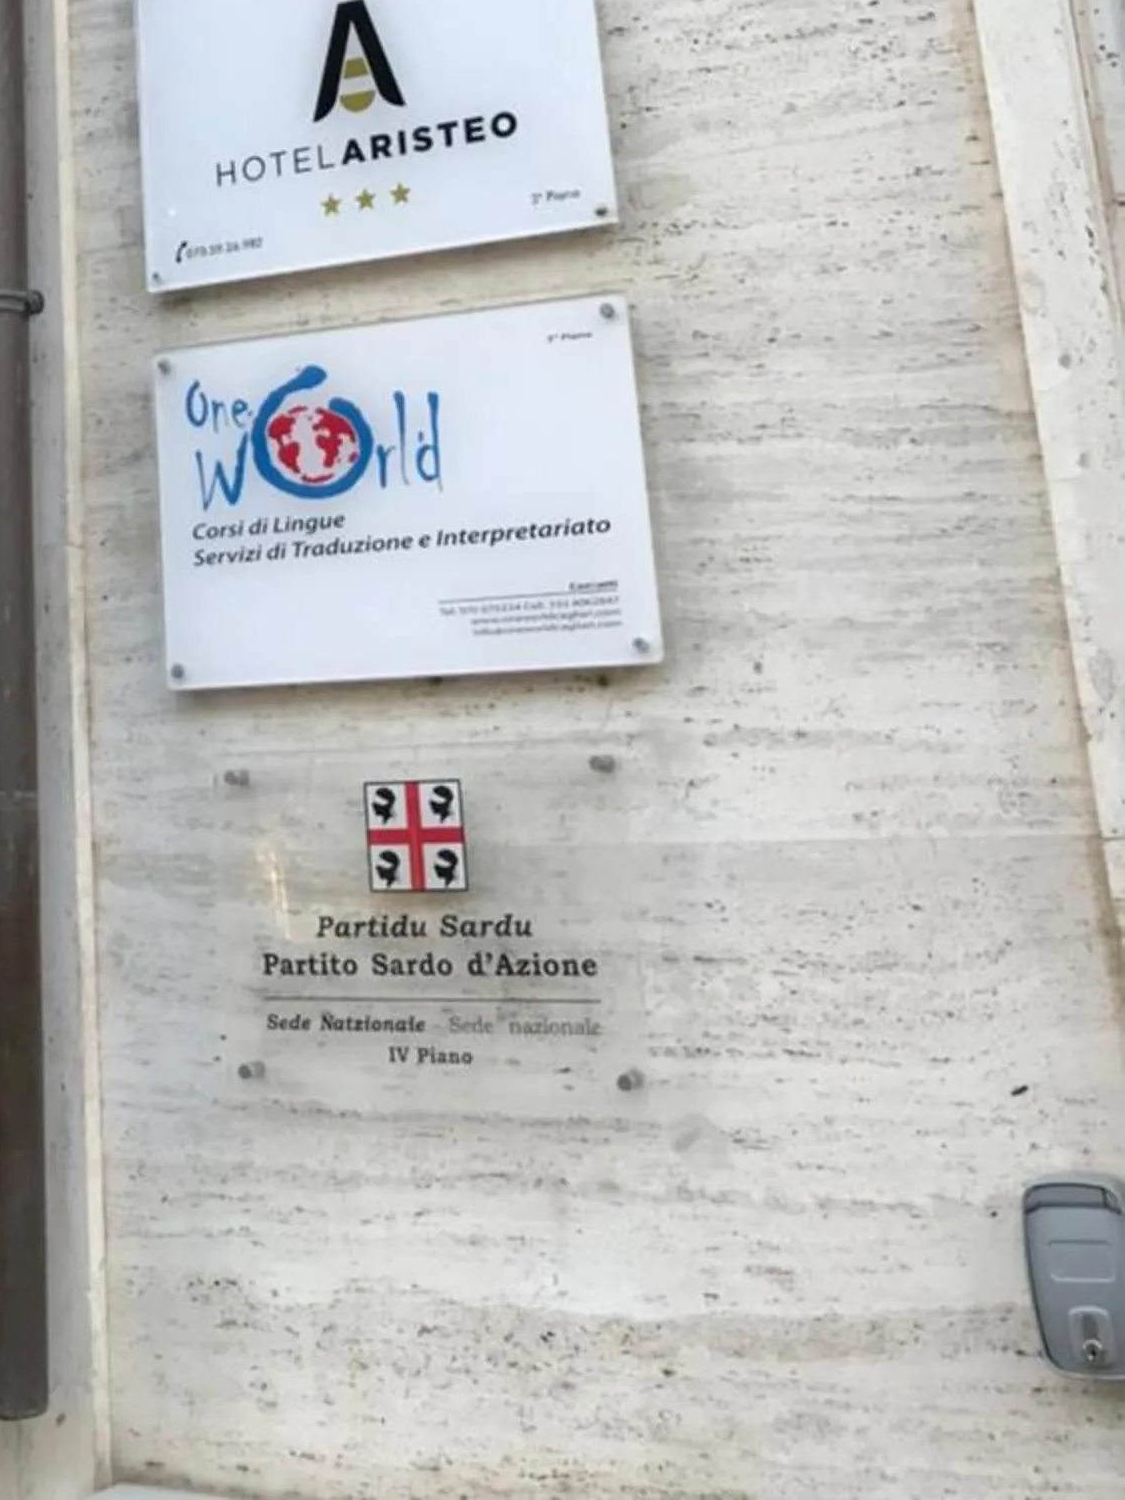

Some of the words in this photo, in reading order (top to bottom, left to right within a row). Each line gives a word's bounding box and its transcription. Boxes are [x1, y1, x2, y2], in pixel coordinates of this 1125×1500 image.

[216, 144, 335, 187] HOTEL
[341, 112, 518, 166] ARISTEO
[186, 380, 248, 433] One
[192, 519, 244, 541] Corsi
[248, 517, 268, 536] di
[273, 513, 346, 535] Lingue
[193, 544, 263, 567] Servizi
[266, 543, 287, 561] di
[293, 534, 414, 559] Traduzione
[418, 533, 432, 549] e
[436, 517, 612, 546] Interpretariato
[315, 914, 428, 939] Partidu
[439, 913, 534, 938] Sardu
[263, 952, 359, 977] Partito
[371, 952, 454, 977] Sardo
[467, 951, 598, 978] d'Azione
[266, 1014, 312, 1032] Sede
[320, 1013, 427, 1033] Natzionale
[447, 1015, 495, 1035] Sede
[508, 1015, 604, 1037] nazionale
[388, 1046, 409, 1064] IV
[417, 1047, 474, 1066] Piano
